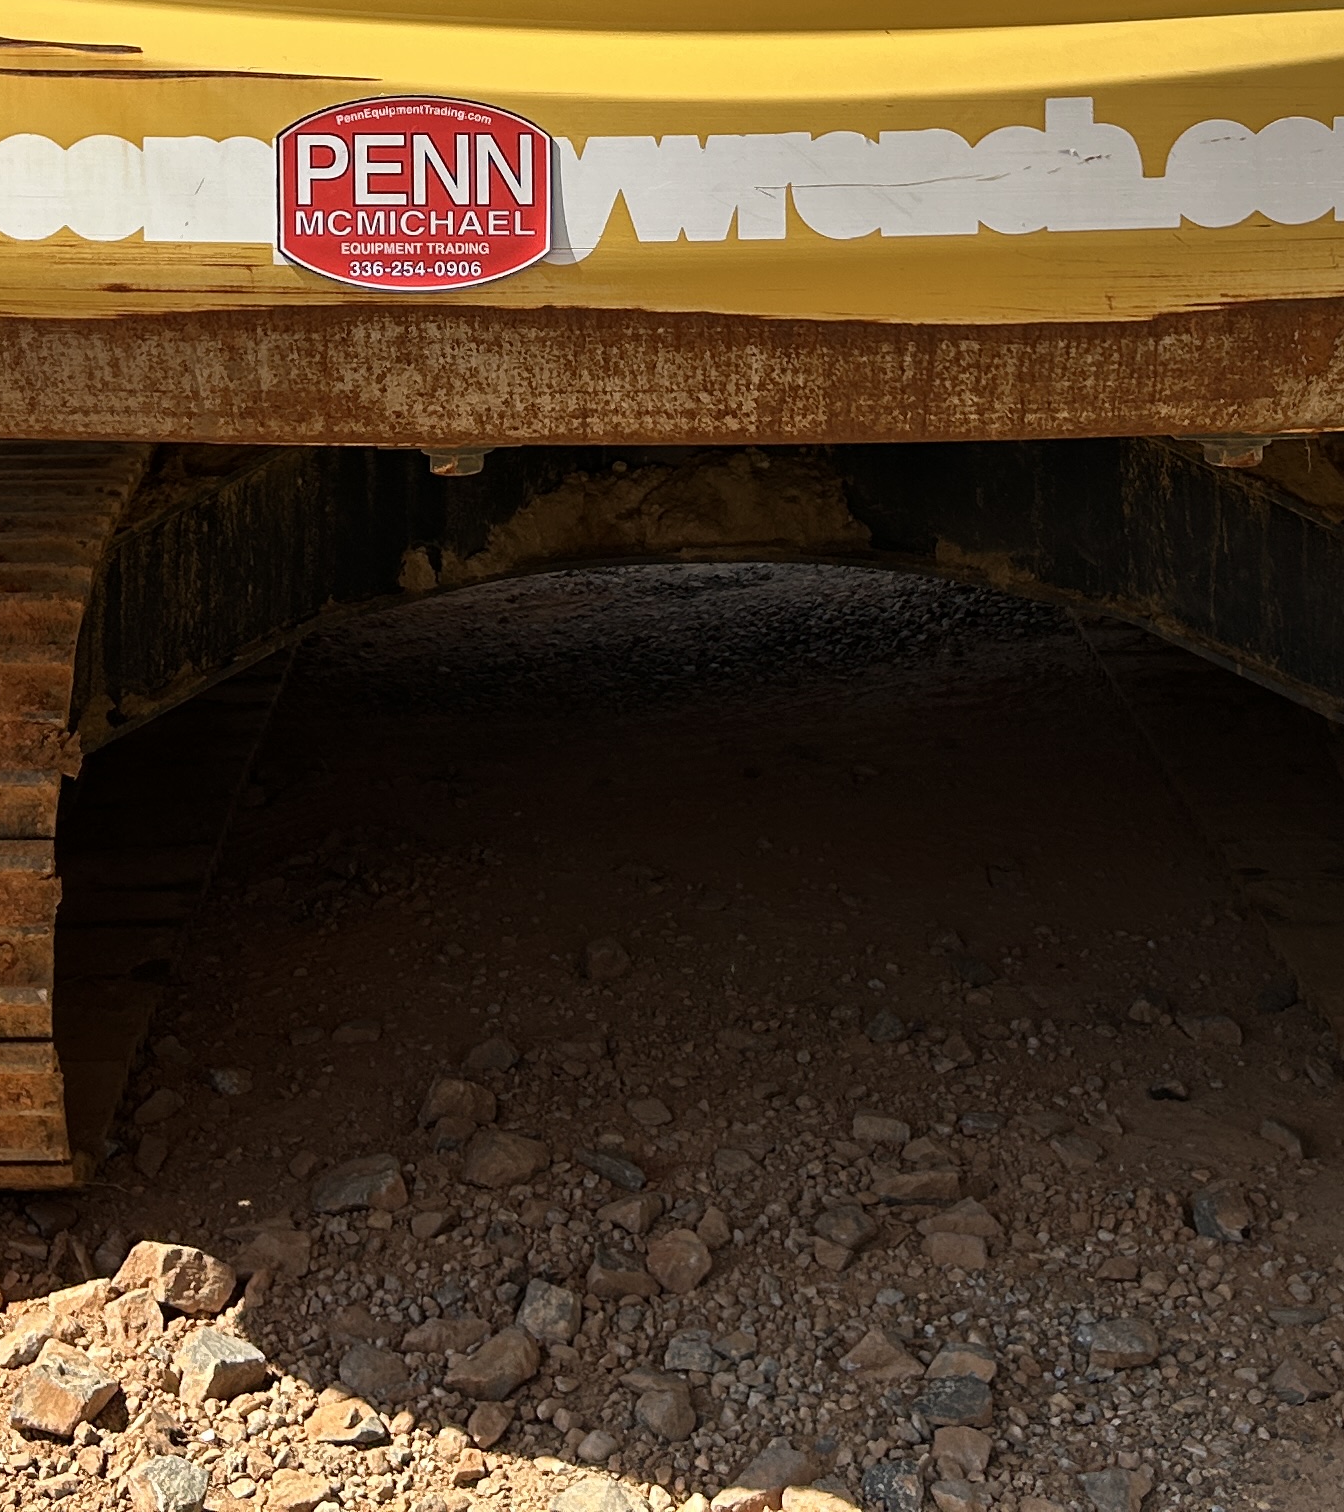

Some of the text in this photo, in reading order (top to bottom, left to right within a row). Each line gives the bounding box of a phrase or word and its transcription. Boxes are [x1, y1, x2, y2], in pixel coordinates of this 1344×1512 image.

[336, 104, 492, 125] PennEquipmentTrading.com
[296, 134, 532, 206] PENN
[294, 210, 536, 236] MCMICHAEL
[340, 242, 490, 256] EQUIPMENT TRADING
[349, 261, 482, 277] 336-254-0906
